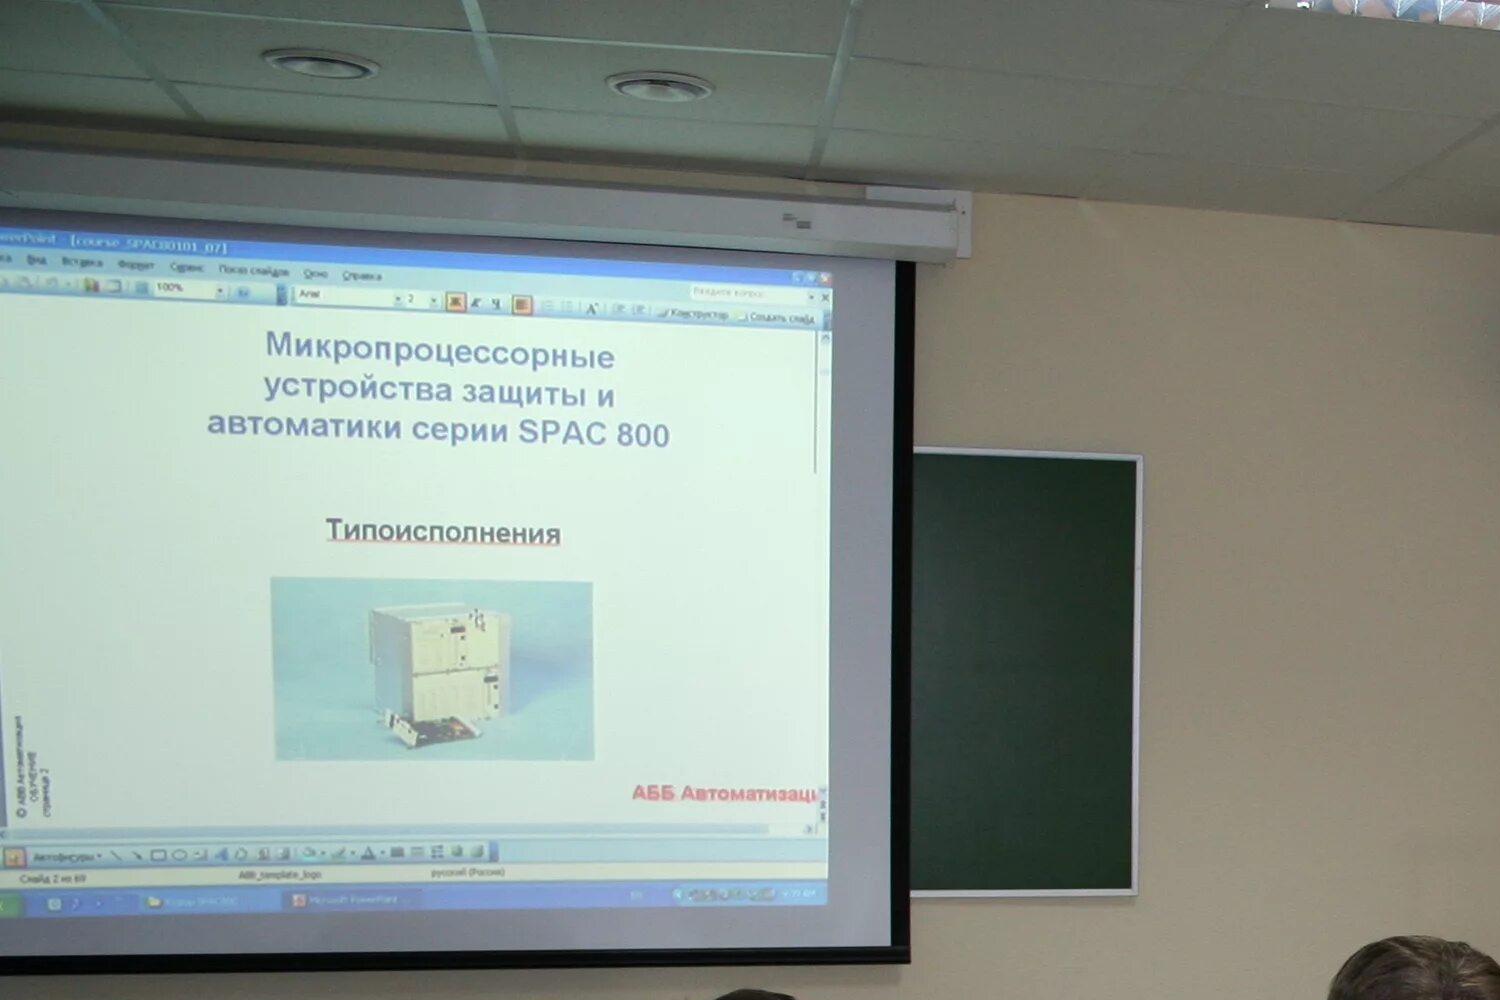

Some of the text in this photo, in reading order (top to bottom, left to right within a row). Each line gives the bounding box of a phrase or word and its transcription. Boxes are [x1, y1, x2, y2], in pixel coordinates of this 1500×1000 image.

[157, 281, 183, 292] 100%
[266, 331, 616, 372] Микропроцессорные
[263, 373, 614, 408] устройства защиты и
[207, 413, 670, 448] автоматики серии SPAC 800
[326, 517, 561, 545] Типоисполнения
[632, 784, 676, 801] АББ
